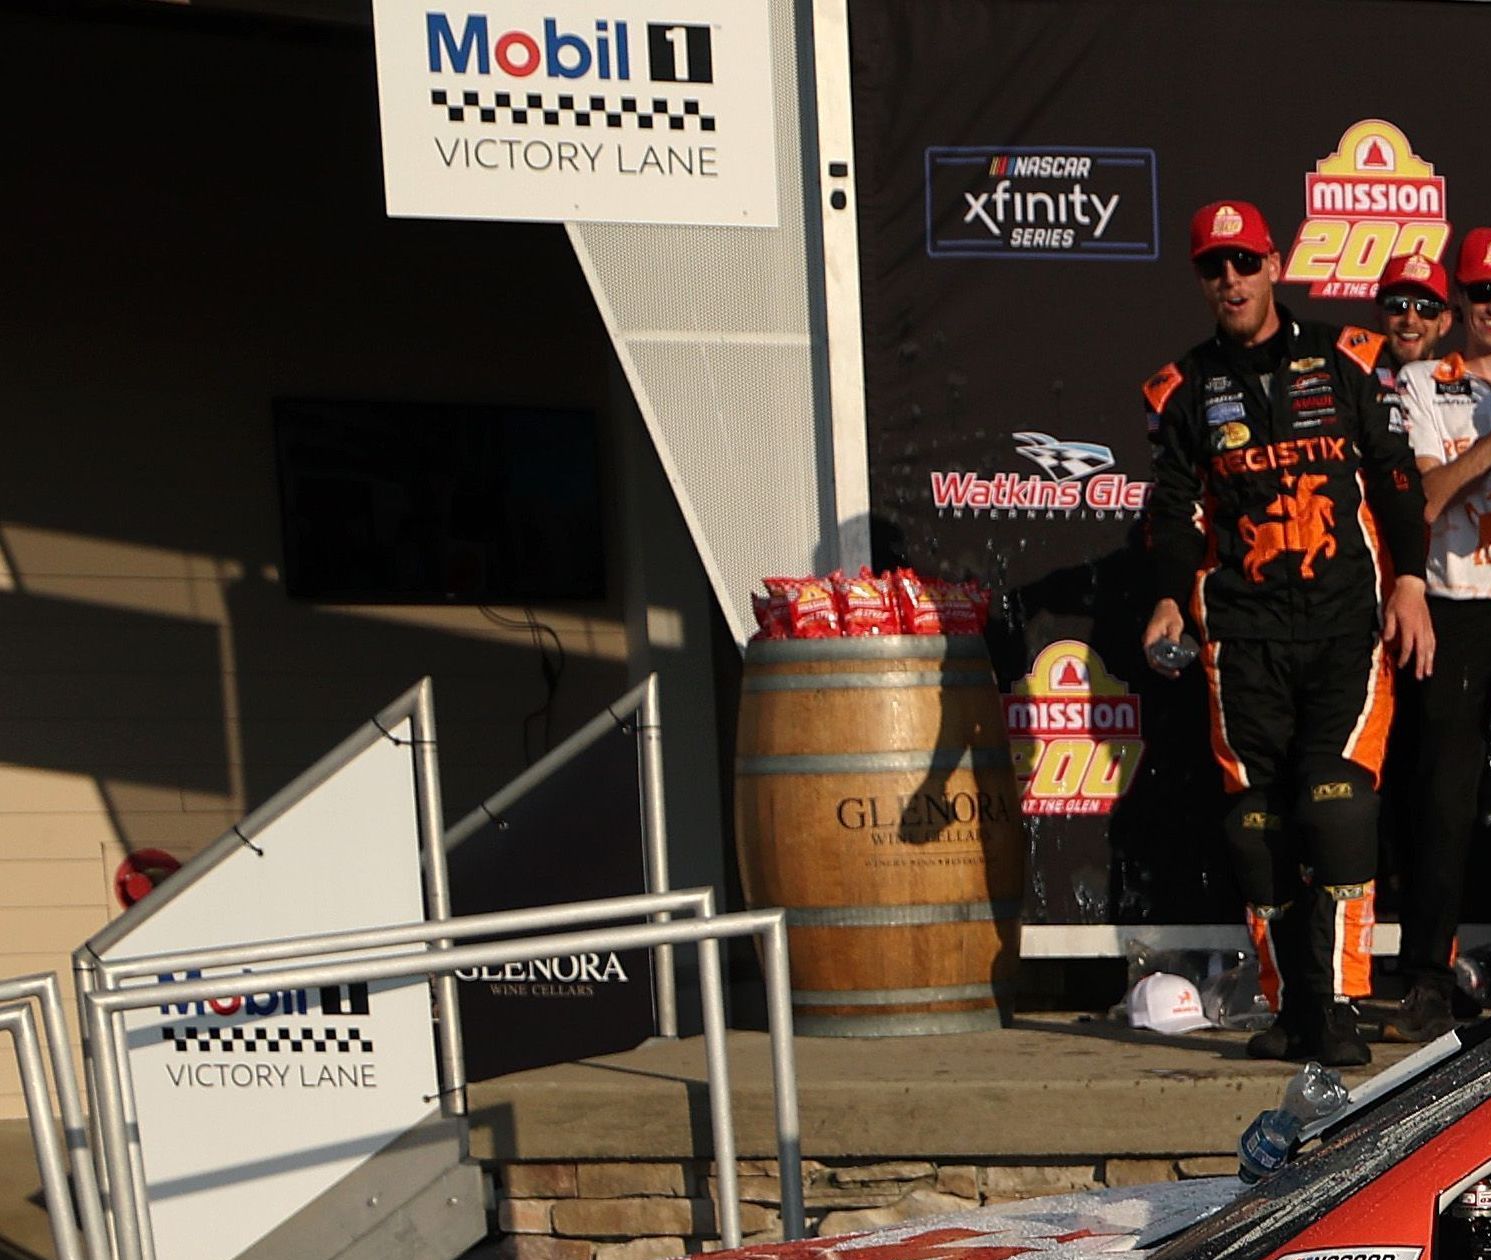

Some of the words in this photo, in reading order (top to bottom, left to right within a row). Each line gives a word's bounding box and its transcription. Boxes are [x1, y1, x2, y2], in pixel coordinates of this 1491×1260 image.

[425, 12, 629, 79] Mobil
[434, 137, 604, 174] VICTORY
[618, 143, 719, 177] LANE
[1012, 156, 1092, 178] NASCAR
[963, 180, 1120, 237] xfinity
[1312, 183, 1440, 214] MISSION
[1010, 227, 1075, 249] SERIES
[931, 473, 1081, 510] Watkins
[939, 509, 1144, 522] INTERNATIONA
[1008, 703, 1134, 732] MISSION
[836, 791, 1009, 830] GLENORA
[490, 984, 530, 996] WINE
[532, 984, 594, 996] CELLARS
[166, 1064, 295, 1088] VICTORY
[301, 1064, 377, 1088] LANE
